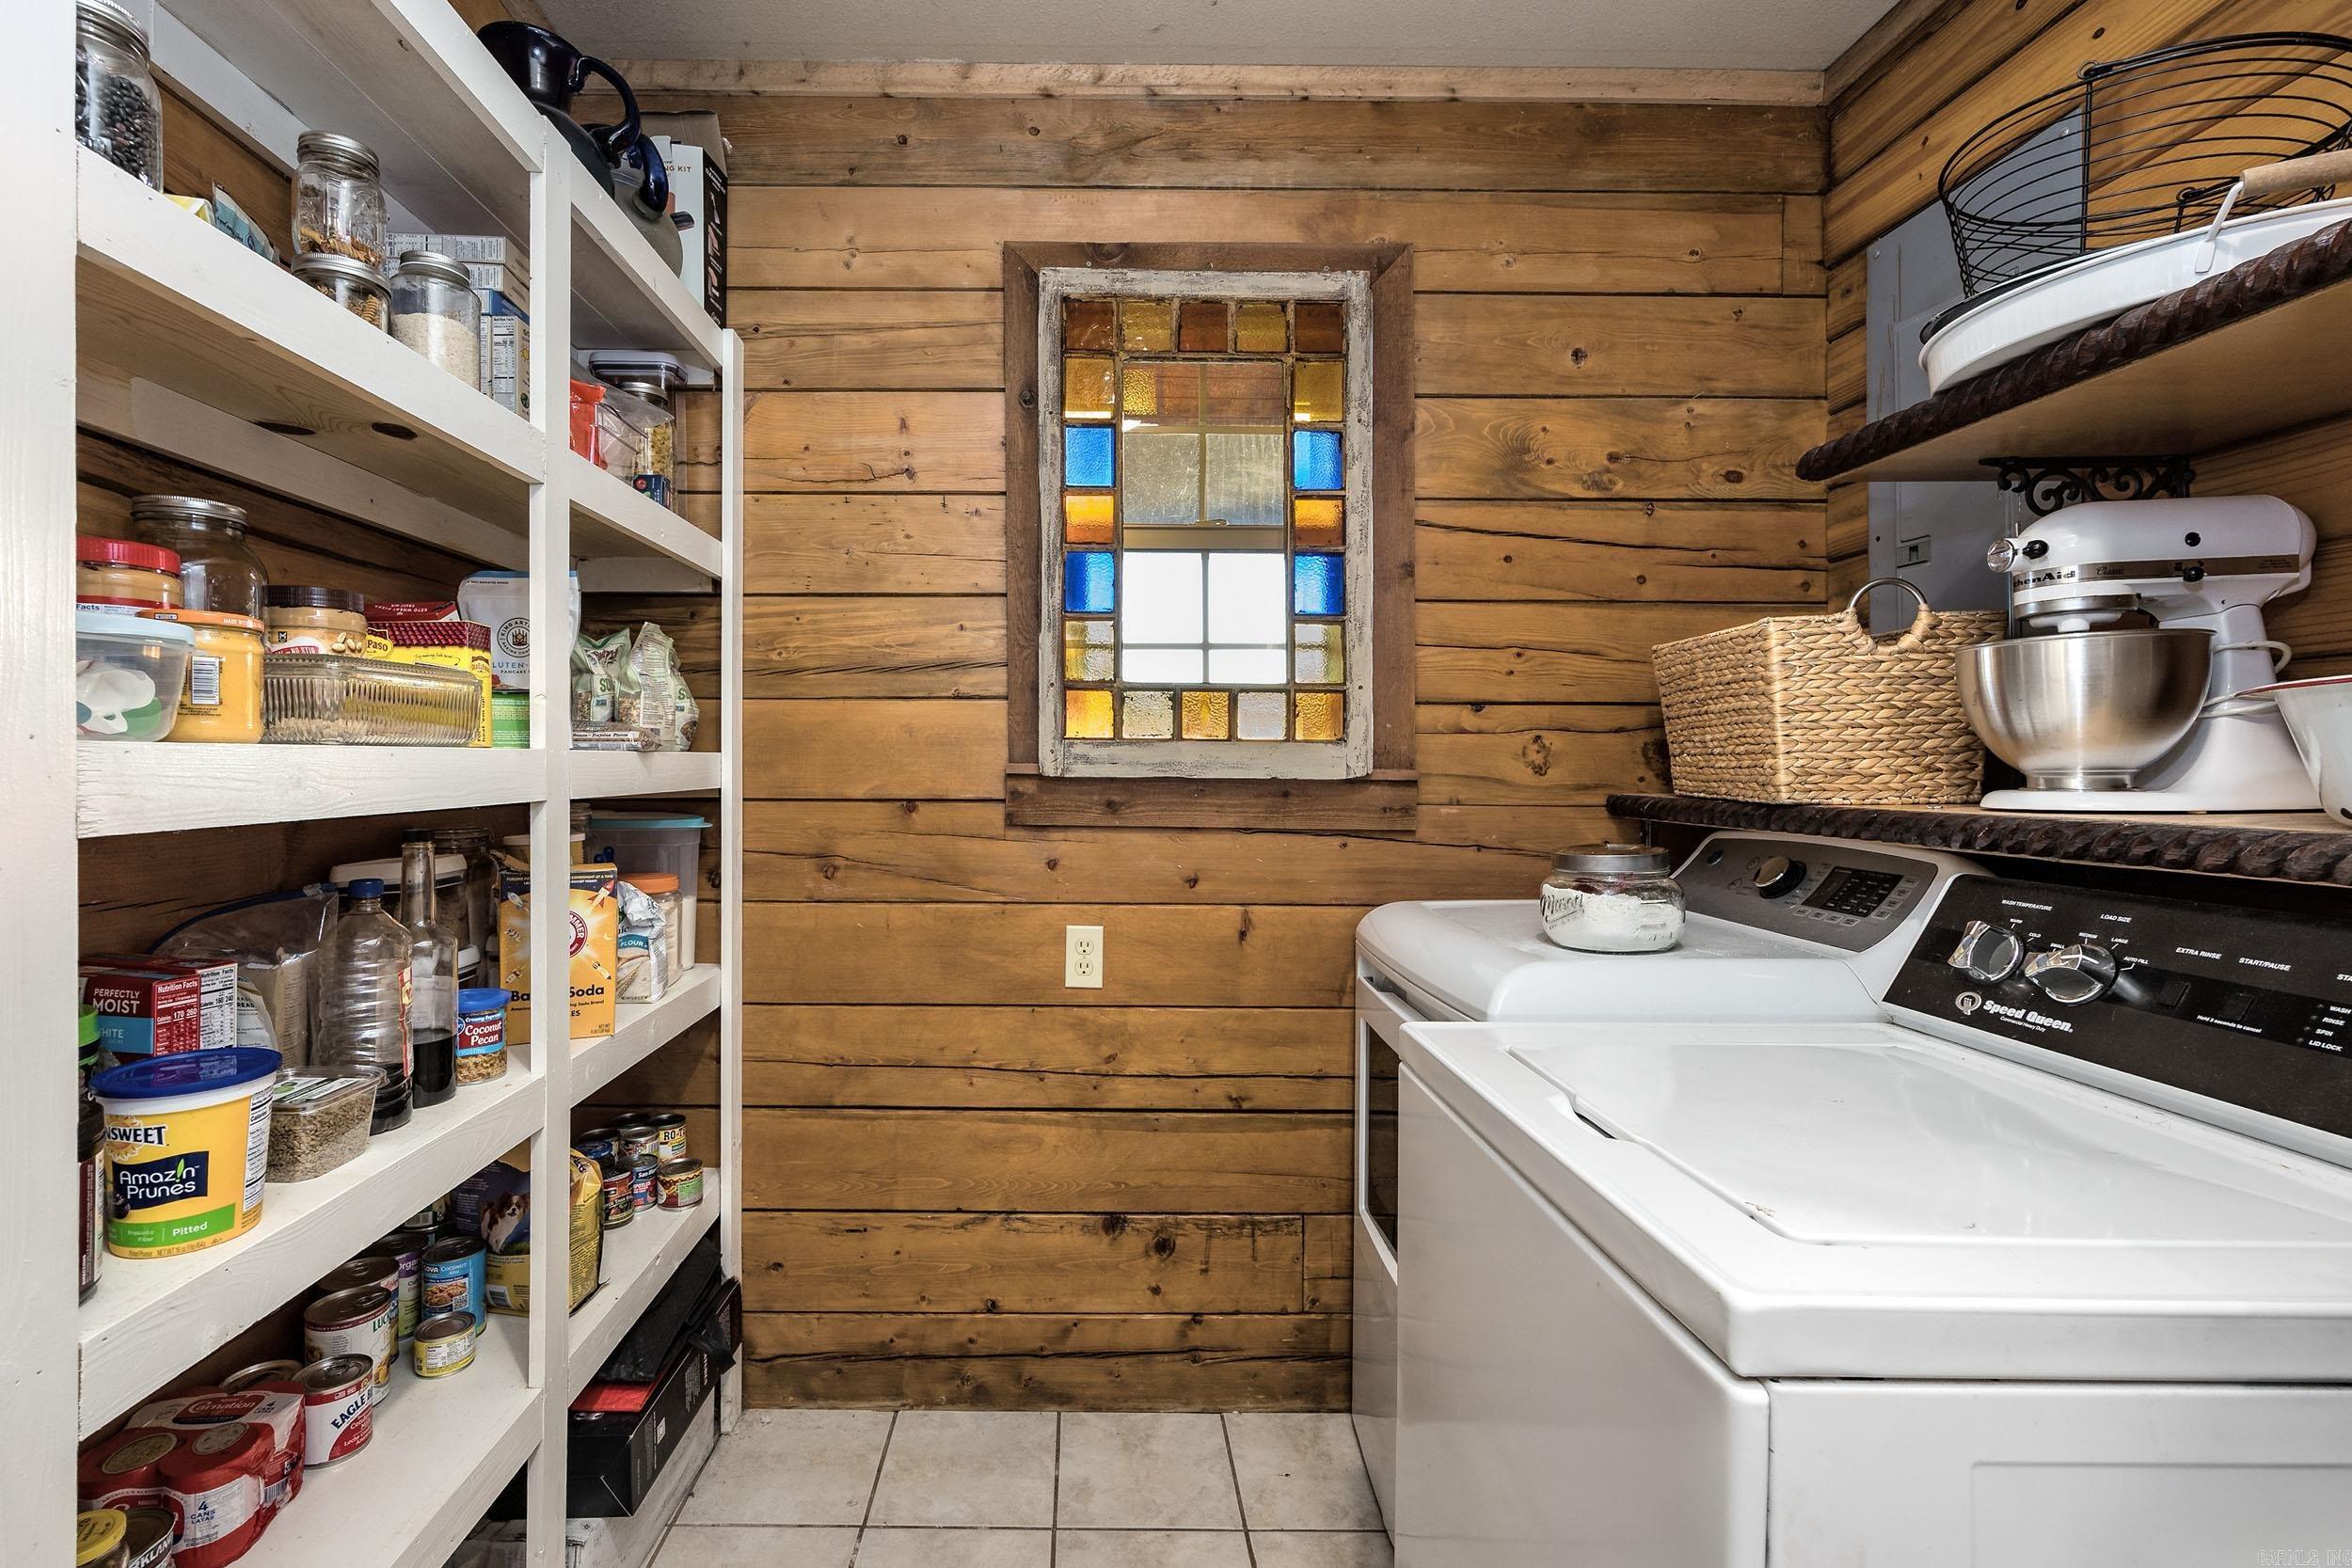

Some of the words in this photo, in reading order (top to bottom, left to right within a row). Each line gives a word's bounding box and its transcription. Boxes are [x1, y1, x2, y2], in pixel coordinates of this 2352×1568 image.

[2013, 571, 2075, 587] chenAid
[76, 603, 101, 611] Facts
[501, 622, 513, 638] KING
[367, 640, 389, 652] Paso
[2016, 900, 2053, 911] TEMPERATURE
[2100, 913, 2116, 922] LOAD
[570, 912, 585, 939] MMER
[621, 940, 644, 948] FLOUR
[2175, 945, 2198, 955] EXTRA
[2199, 950, 2221, 959] RINSE
[2238, 957, 2291, 972] START/PAUSE
[2336, 973, 2352, 982] STA
[157, 981, 183, 994] Nutrition
[183, 979, 198, 990] Facts
[569, 984, 605, 998] Soda
[94, 988, 141, 1000] PERFECTLY
[92, 998, 140, 1015] MOIST
[1982, 999, 2024, 1020] Speed
[2328, 1005, 2352, 1014] WASH
[173, 1009, 184, 1020] 170
[1999, 1015, 2022, 1025] Commercial
[2022, 1021, 2034, 1030] Heavy
[2214, 1019, 2235, 1028] seconds
[2242, 1024, 2262, 1033] cancel
[2322, 1017, 2345, 1026] RINSE
[99, 1027, 124, 1038] HITE
[465, 1020, 502, 1037] Coconut
[2314, 1027, 2333, 1037] SPIN
[470, 1034, 499, 1046] Pecan
[2308, 1038, 2321, 1048] LID
[2321, 1042, 2343, 1052] LOCK
[105, 1125, 167, 1146] NSWEET
[127, 1180, 197, 1199] Prunes
[127, 1228, 155, 1237] Prebiotic
[172, 1221, 208, 1238] Pitted
[137, 1235, 154, 1243] Fiber
[167, 1247, 175, 1256] WT
[188, 1400, 256, 1414] Carnation
[330, 1393, 366, 1430] EAGLE
[198, 1500, 209, 1512] 4
[190, 1510, 216, 1520] CANS
[191, 1515, 215, 1525] LATAS
[131, 1537, 173, 1568] RKLAN
